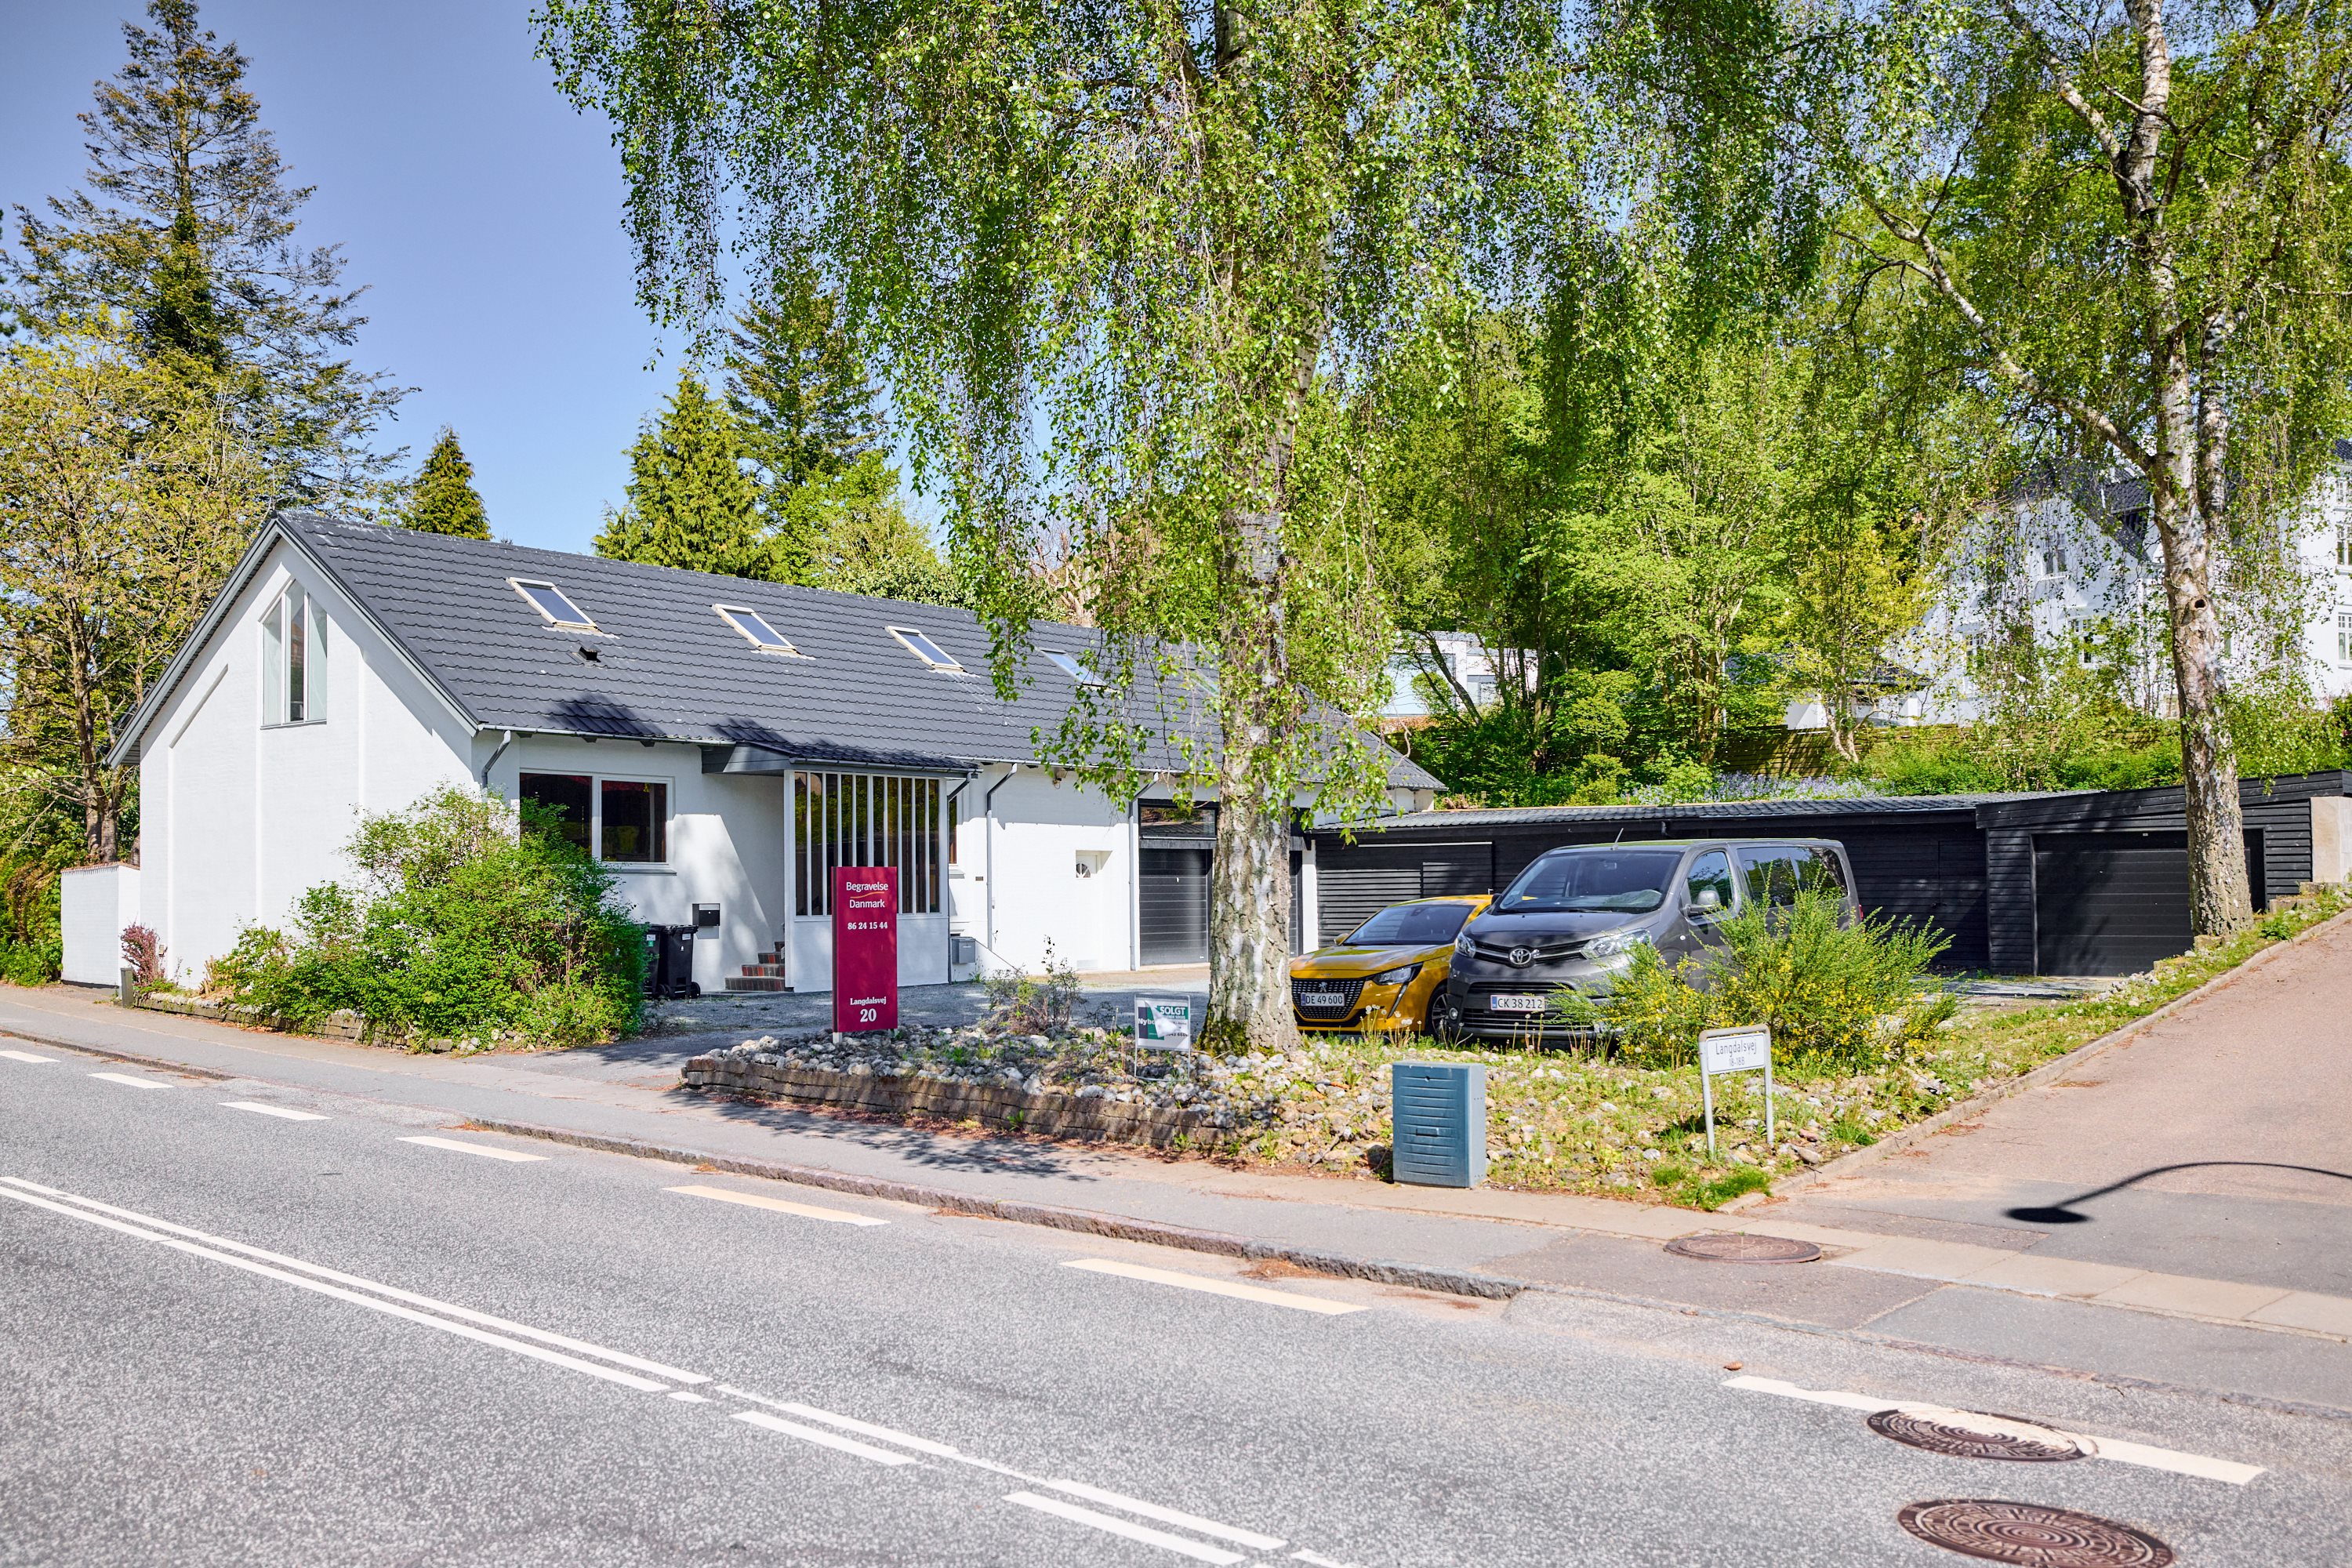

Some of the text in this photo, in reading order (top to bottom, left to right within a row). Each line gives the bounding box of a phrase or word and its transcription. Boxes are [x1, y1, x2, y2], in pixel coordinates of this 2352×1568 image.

[846, 881, 888, 892] Begravelse
[849, 899, 885, 909] Danmark
[850, 996, 887, 1006] Langdalsvej
[1305, 996, 1343, 1004] DE 49 600
[1497, 998, 1543, 1009] CK 38 212
[860, 1008, 877, 1022] 20
[1160, 1006, 1185, 1015] SOLGT
[1715, 1039, 1757, 1058] Langdalsvej
